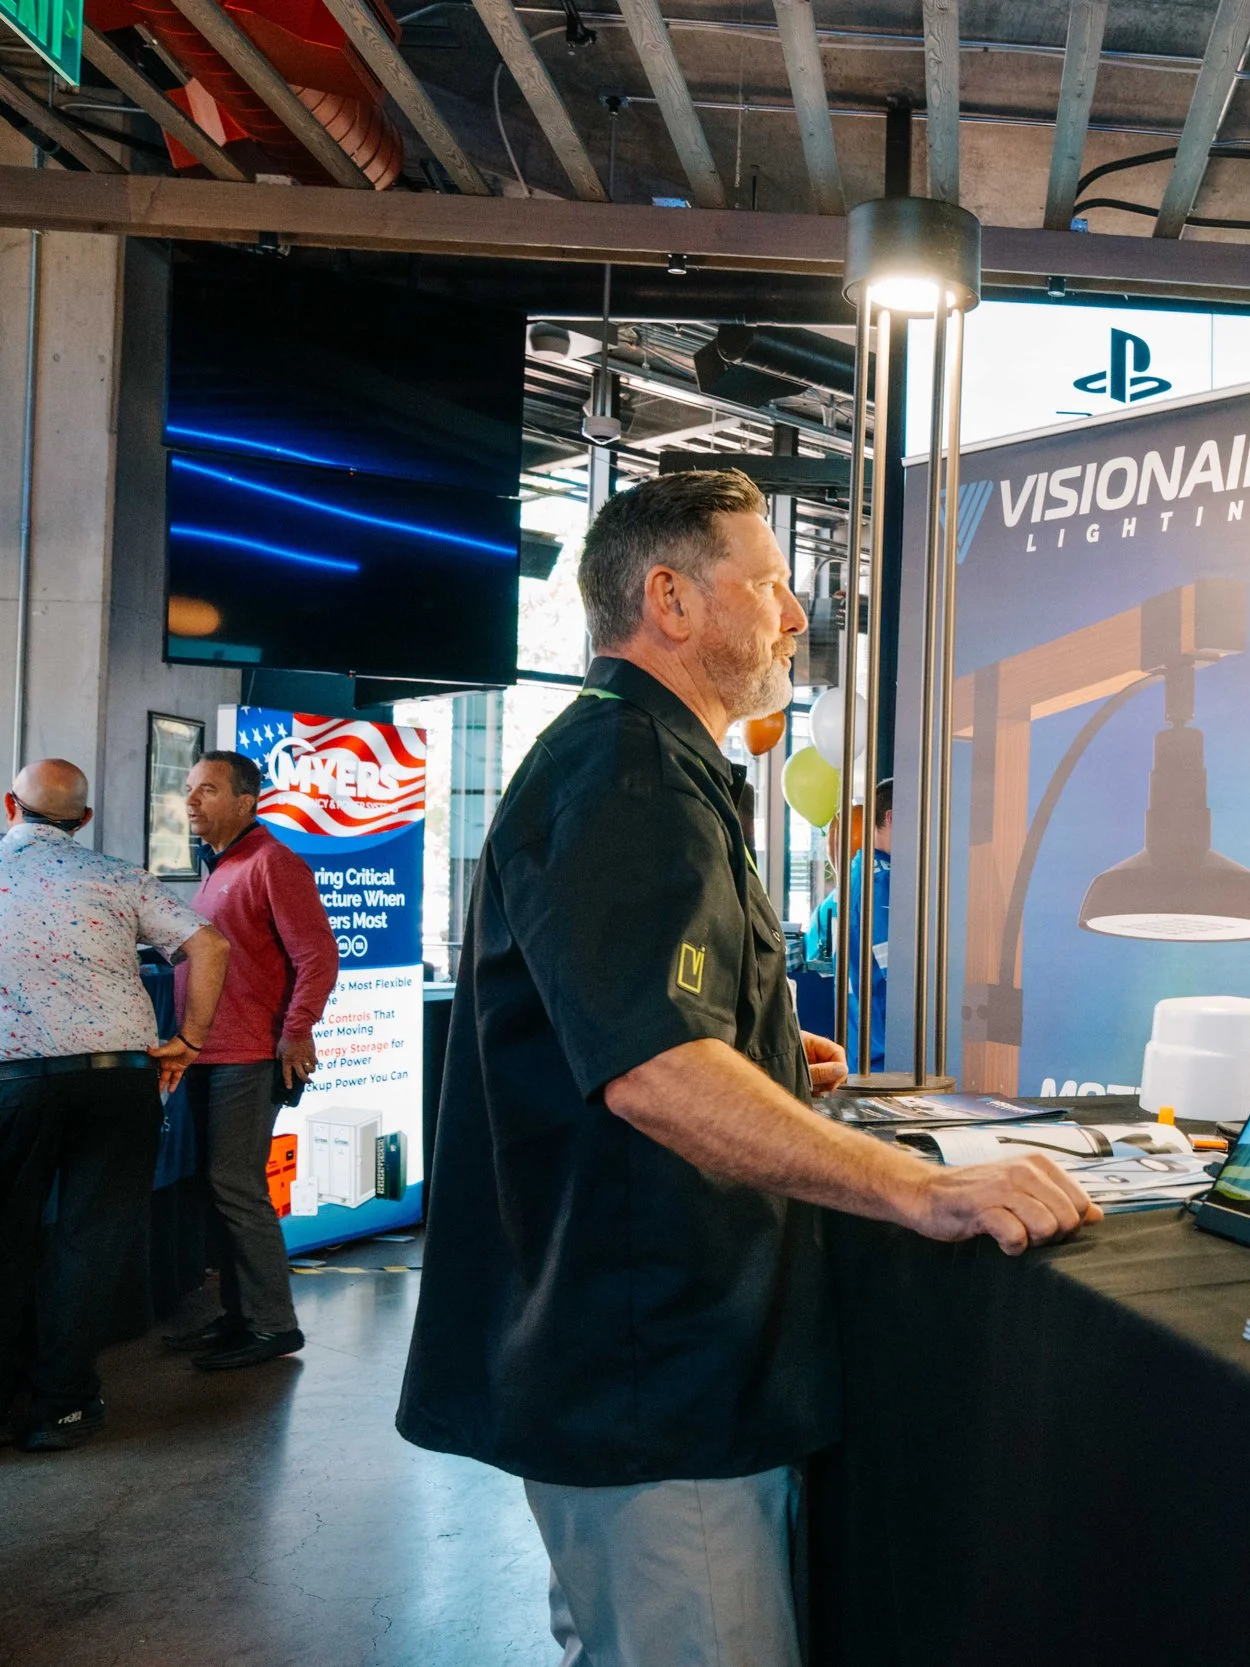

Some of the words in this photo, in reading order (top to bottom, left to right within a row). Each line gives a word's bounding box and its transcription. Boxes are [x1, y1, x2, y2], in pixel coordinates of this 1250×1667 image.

[277, 750, 400, 799] MYERS
[314, 867, 344, 889] ring
[345, 868, 396, 886] Critical
[320, 890, 362, 907] ucture
[363, 890, 405, 907] When
[328, 915, 351, 929] ers
[353, 911, 388, 929] Most
[349, 981, 372, 991] Most
[375, 977, 413, 988] Flexible
[328, 1011, 371, 1024] Controls
[373, 1010, 395, 1020] That
[313, 1029, 333, 1039] wer
[337, 1024, 374, 1036] Moving
[317, 1046, 347, 1058] nergy
[350, 1041, 388, 1053] Storage
[391, 1038, 404, 1048] for
[327, 1059, 337, 1069] of
[340, 1056, 372, 1067] Power
[306, 1081, 332, 1093] ckup
[335, 1076, 367, 1088] Power
[370, 1073, 388, 1083] You
[390, 1070, 409, 1081] Can
